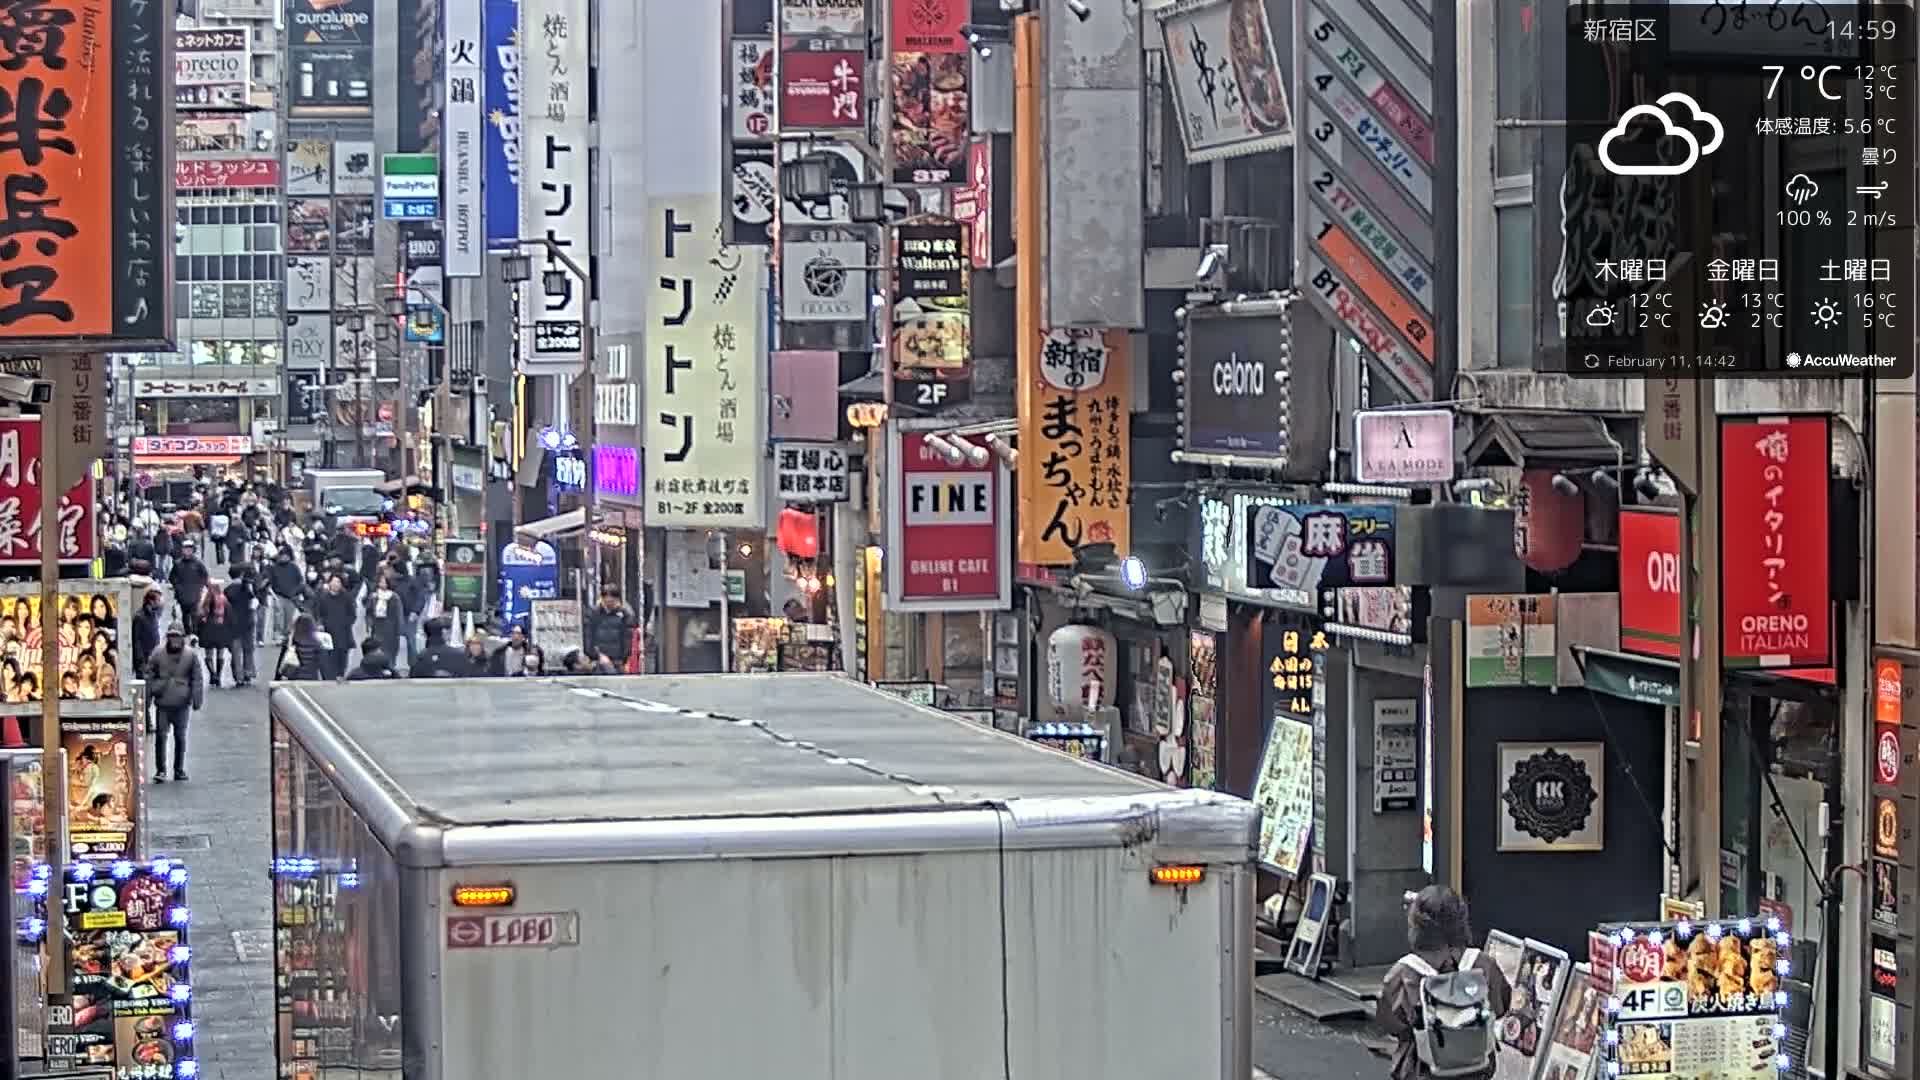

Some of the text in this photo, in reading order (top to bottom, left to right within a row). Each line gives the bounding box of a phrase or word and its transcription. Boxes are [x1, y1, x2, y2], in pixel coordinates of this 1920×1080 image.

[1314, 21, 1336, 42] 5
[450, 38, 477, 105] 火鍋
[1314, 75, 1334, 91] 4
[1314, 121, 1335, 142] 3
[386, 180, 436, 192] FamilyMart
[914, 168, 949, 183] 3F
[1314, 171, 1334, 193] 2
[1311, 267, 1340, 297] B1
[660, 208, 692, 462] トントン
[1212, 351, 1265, 396] celona
[917, 383, 947, 404] 2F
[1041, 394, 1087, 548] まっちゃん
[911, 483, 987, 513] FINE
[1350, 517, 1391, 535] フリー
[1754, 429, 1789, 604] 俺のイタリアン
[1303, 511, 1347, 556] 麻
[1741, 615, 1809, 634] ORENO
[1740, 633, 1809, 651] ITALIAN
[1536, 781, 1565, 799] KK
[1621, 988, 1656, 1013] 4F
